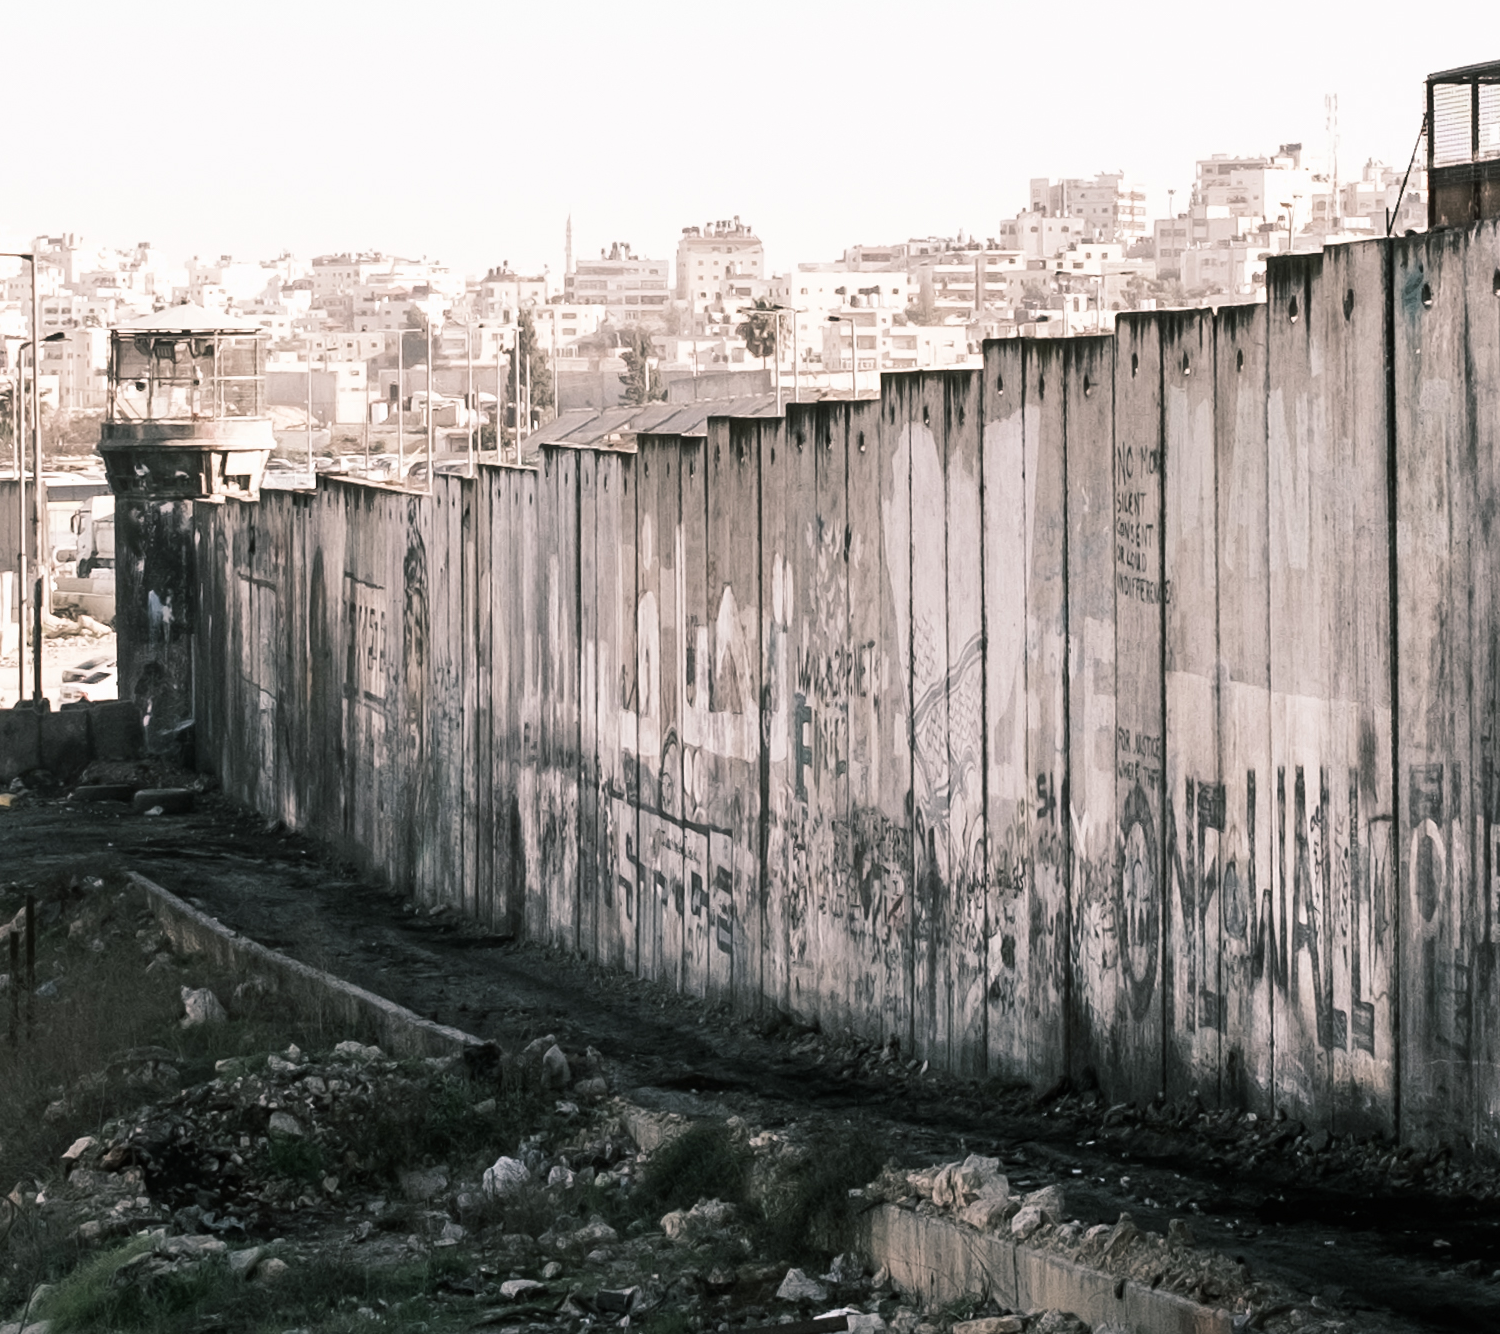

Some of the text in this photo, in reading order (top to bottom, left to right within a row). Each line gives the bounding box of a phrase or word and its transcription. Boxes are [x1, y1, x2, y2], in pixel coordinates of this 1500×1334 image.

[1117, 441, 1134, 485] NO
[1116, 492, 1147, 516] SILENT
[1116, 516, 1154, 549] CONSENT
[1116, 573, 1171, 604] INDIFFERENE
[1118, 726, 1161, 760] FOR JUSTICE
